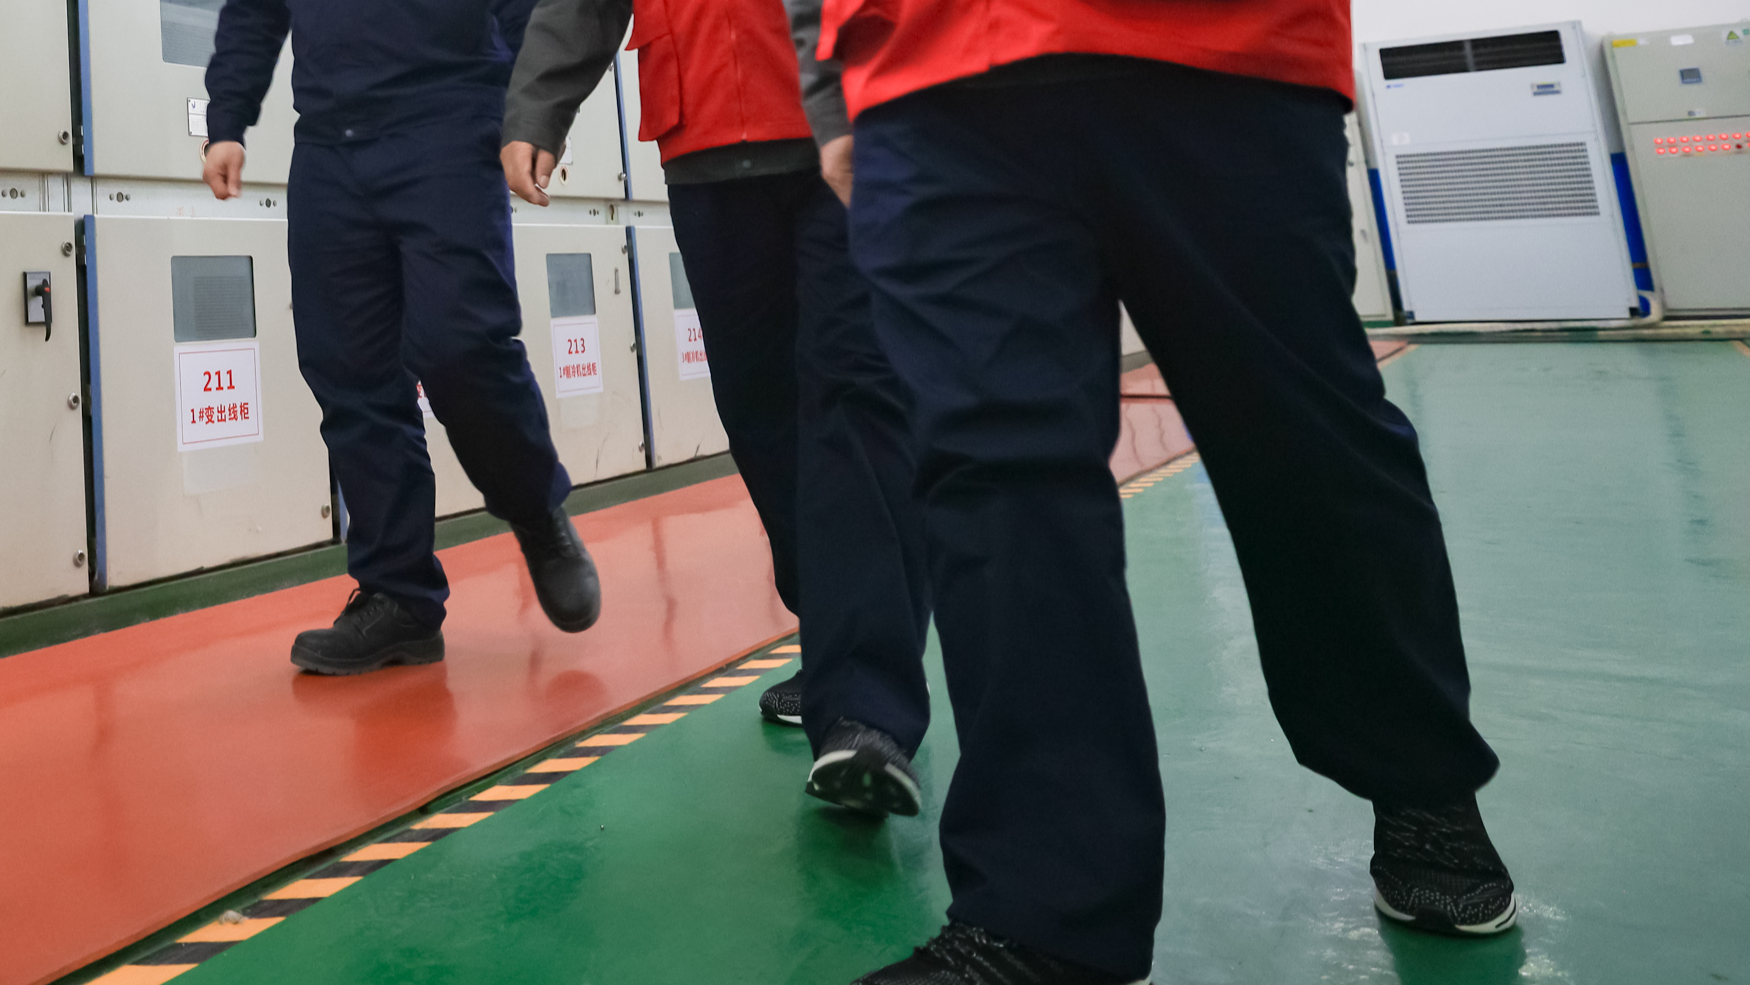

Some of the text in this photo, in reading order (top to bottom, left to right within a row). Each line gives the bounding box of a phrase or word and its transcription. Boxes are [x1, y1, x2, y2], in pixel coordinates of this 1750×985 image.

[567, 337, 586, 354] 213
[203, 369, 235, 392] 211
[190, 402, 250, 425] 1#变出线柜
